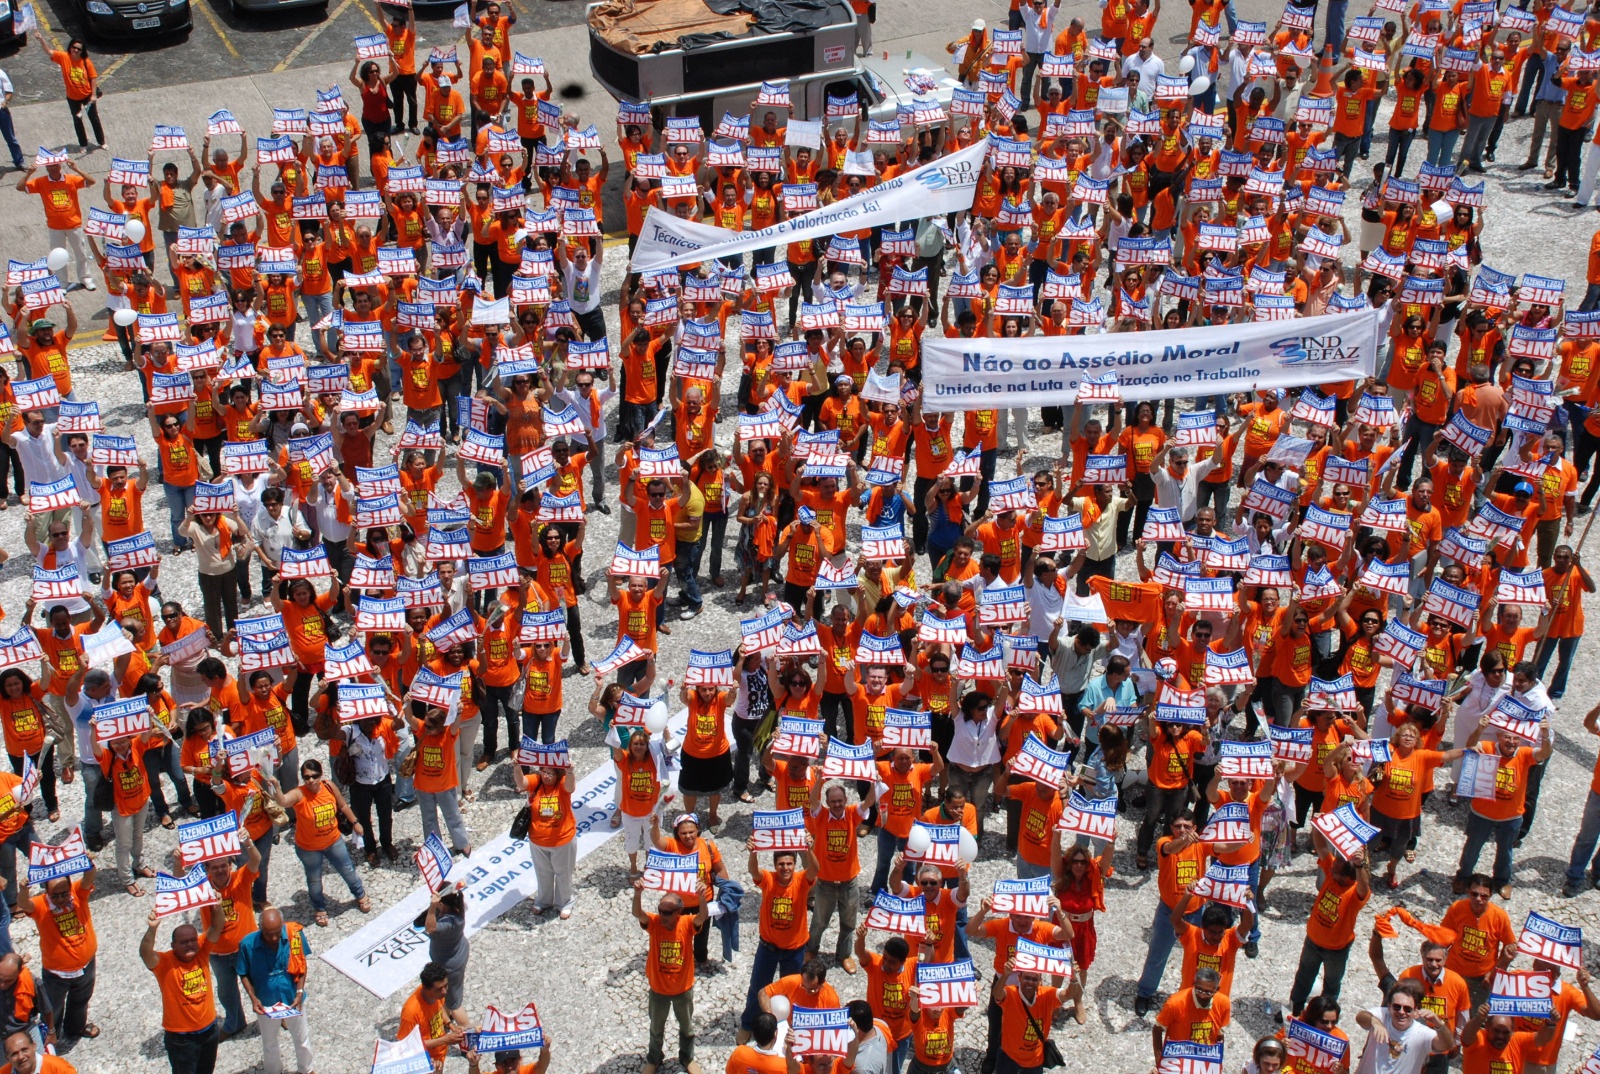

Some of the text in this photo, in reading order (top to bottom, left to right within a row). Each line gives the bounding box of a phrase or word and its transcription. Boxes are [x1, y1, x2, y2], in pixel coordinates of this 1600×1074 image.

[1545, 18, 1579, 37] SIM
[757, 92, 789, 104] SIM
[1156, 85, 1188, 96] SIM
[1296, 108, 1330, 124] SIM
[153, 136, 189, 150] SIM
[258, 148, 295, 164] SIM
[110, 170, 149, 188] SIM
[662, 183, 698, 196] SIM
[345, 204, 380, 217] SIM
[778, 200, 882, 233] e Valorização Já!
[653, 224, 704, 250] Técnicos
[1199, 237, 1236, 252] SIM
[882, 240, 915, 255] SIM
[379, 260, 415, 274] SIM
[1411, 251, 1447, 267] SIM
[511, 289, 550, 302] SIM
[844, 316, 883, 330] SIM
[140, 326, 179, 341] SIM
[963, 341, 1240, 372] Não ao Assédio Moral
[1510, 339, 1551, 358] SIM
[936, 367, 1261, 395] Unidade na Luta e rização no Trabalho
[1079, 384, 1119, 397] SIM
[1176, 428, 1216, 445] SIM
[1441, 425, 1485, 456] SIM
[226, 455, 269, 472] SIM
[640, 461, 680, 475] SIM
[1083, 468, 1125, 483] SIM
[30, 490, 80, 512] SIM
[1331, 516, 1350, 528] LEGAL
[1300, 519, 1347, 548] SIM
[640, 548, 658, 558] LEGAL
[862, 540, 905, 557] SIM
[612, 559, 660, 576] SIM
[470, 569, 518, 590] SIM
[1524, 573, 1543, 585] LEGAL
[34, 581, 83, 599] SIM
[1433, 580, 1479, 608] FAZENDA LEGAL
[1497, 585, 1545, 602] SIM
[1424, 594, 1474, 627] SIM
[766, 612, 781, 627] LEGAL
[237, 621, 285, 636] FAZENDA LEGAL
[521, 624, 567, 640] SIM
[271, 635, 287, 649] LEGAL
[744, 623, 784, 652] SIM
[242, 648, 296, 669] SIM
[713, 654, 731, 664] LEGAL
[1229, 653, 1246, 666] LEGAL
[686, 667, 733, 685] SIM
[1205, 666, 1252, 683] SIM
[365, 688, 385, 698] LEGAL
[94, 699, 147, 721] FAZENDA LEGAL
[339, 697, 387, 717] SIM
[95, 712, 150, 738] SIM
[885, 713, 930, 725] FAZENDA LEGAL
[1490, 708, 1539, 741] SIM
[805, 724, 824, 735] LEGAL
[882, 727, 931, 746] SIM
[773, 735, 820, 758] SIM
[829, 744, 873, 758] FAZENDA LEGAL
[1025, 741, 1067, 768] FAZENDA LEGAL
[1221, 744, 1270, 757] FAZENDA LEGAL
[825, 759, 876, 780] SIM
[1014, 751, 1064, 783] SIM
[1220, 757, 1272, 775] SIM
[753, 813, 805, 827] FAZENDA LEGAL
[1060, 807, 1115, 835] SIM
[1338, 805, 1375, 840] FAZENDA LEGAL
[179, 817, 236, 842] FAZENDA LEGAL
[754, 829, 808, 847] SIM
[1316, 813, 1363, 854] SIM
[31, 834, 85, 865] SIM
[181, 832, 240, 861] SIM
[29, 857, 89, 880] FAZENDA LEGAL
[647, 856, 697, 869] FAZENDA LEGAL
[156, 868, 206, 892] FAZENDA LEGAL
[643, 870, 696, 893] SIM
[995, 880, 1050, 893] FAZENDA LEGAL
[156, 882, 216, 913] SIM
[874, 895, 924, 911] FAZENDA LEGAL
[992, 894, 1050, 914] SIM
[869, 907, 925, 933] SIM
[1525, 918, 1581, 945] FAZENDA LEGAL
[1017, 941, 1046, 955] FAZENDA
[1521, 931, 1580, 966] SIM
[1016, 952, 1071, 975] SIM
[919, 965, 974, 981] FAZENDA LEGAL
[920, 981, 978, 1004] SIM
[1492, 974, 1550, 998] SIM
[1491, 999, 1551, 1013] FAZENDA LEGAL
[482, 1010, 537, 1032] SIM
[792, 1012, 850, 1027] FAZENDA LEGAL
[479, 1034, 507, 1049] LEGAL
[509, 1029, 540, 1044] FAZENDA
[792, 1029, 848, 1052] SIM
